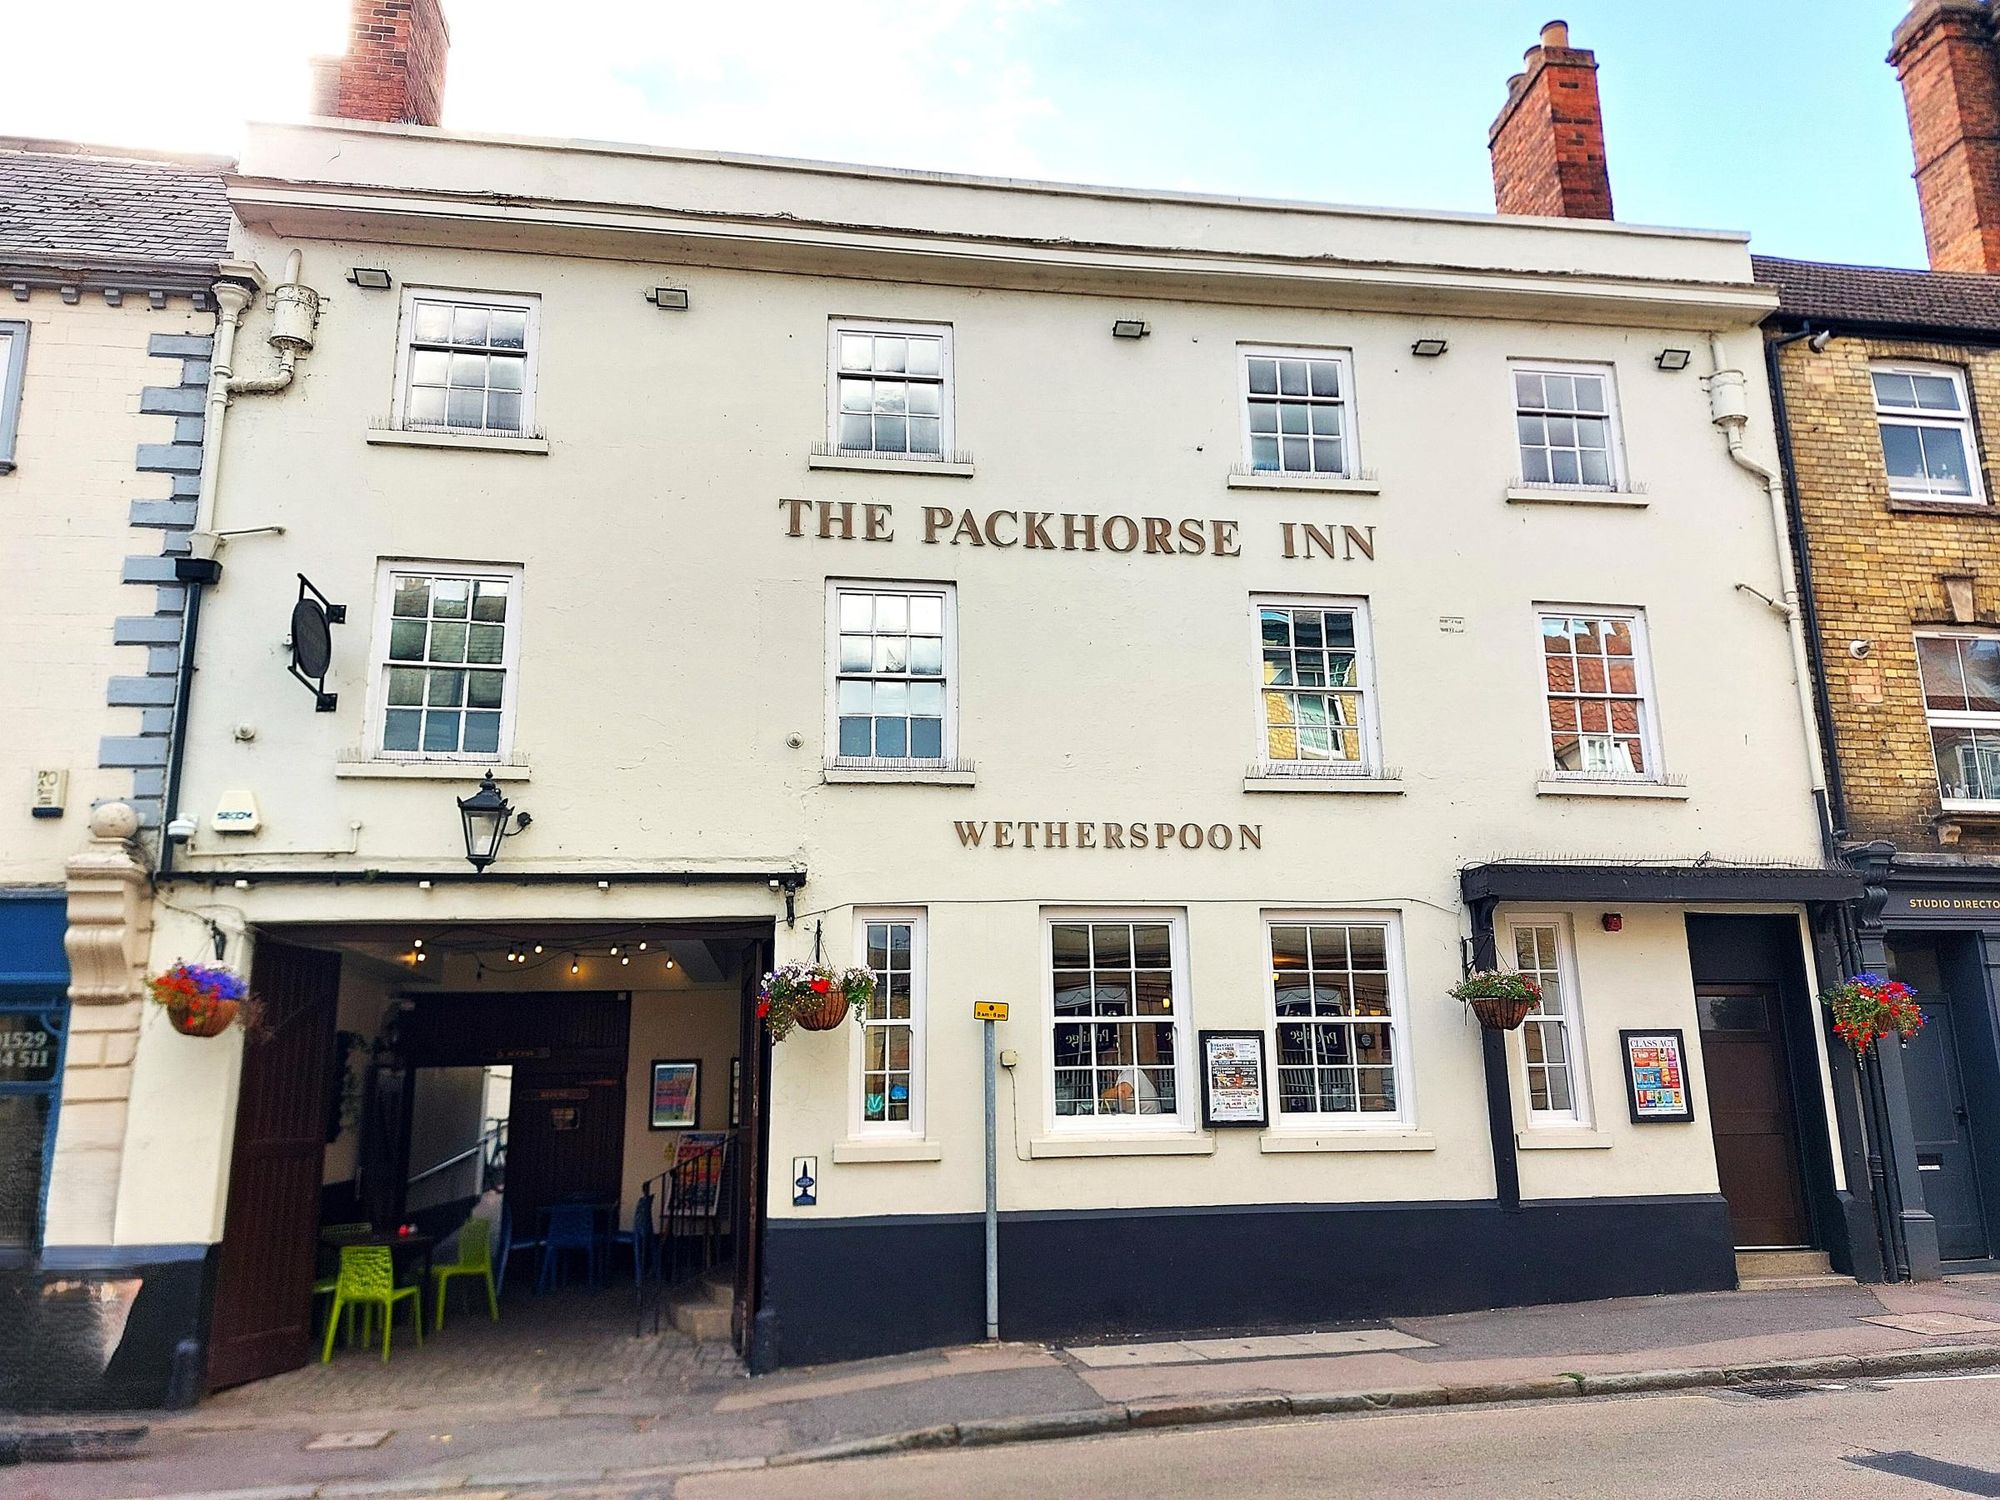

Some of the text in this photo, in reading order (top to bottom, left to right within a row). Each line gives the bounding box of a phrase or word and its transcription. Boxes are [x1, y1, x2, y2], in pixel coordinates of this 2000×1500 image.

[779, 498, 1377, 561] THE PACKHORSE INN
[953, 820, 1264, 850] WETHERSPOON
[1909, 899, 2000, 910] STUDIO DIRECTO
[0, 1031, 47, 1049] 1529
[17, 1050, 49, 1068] 511
